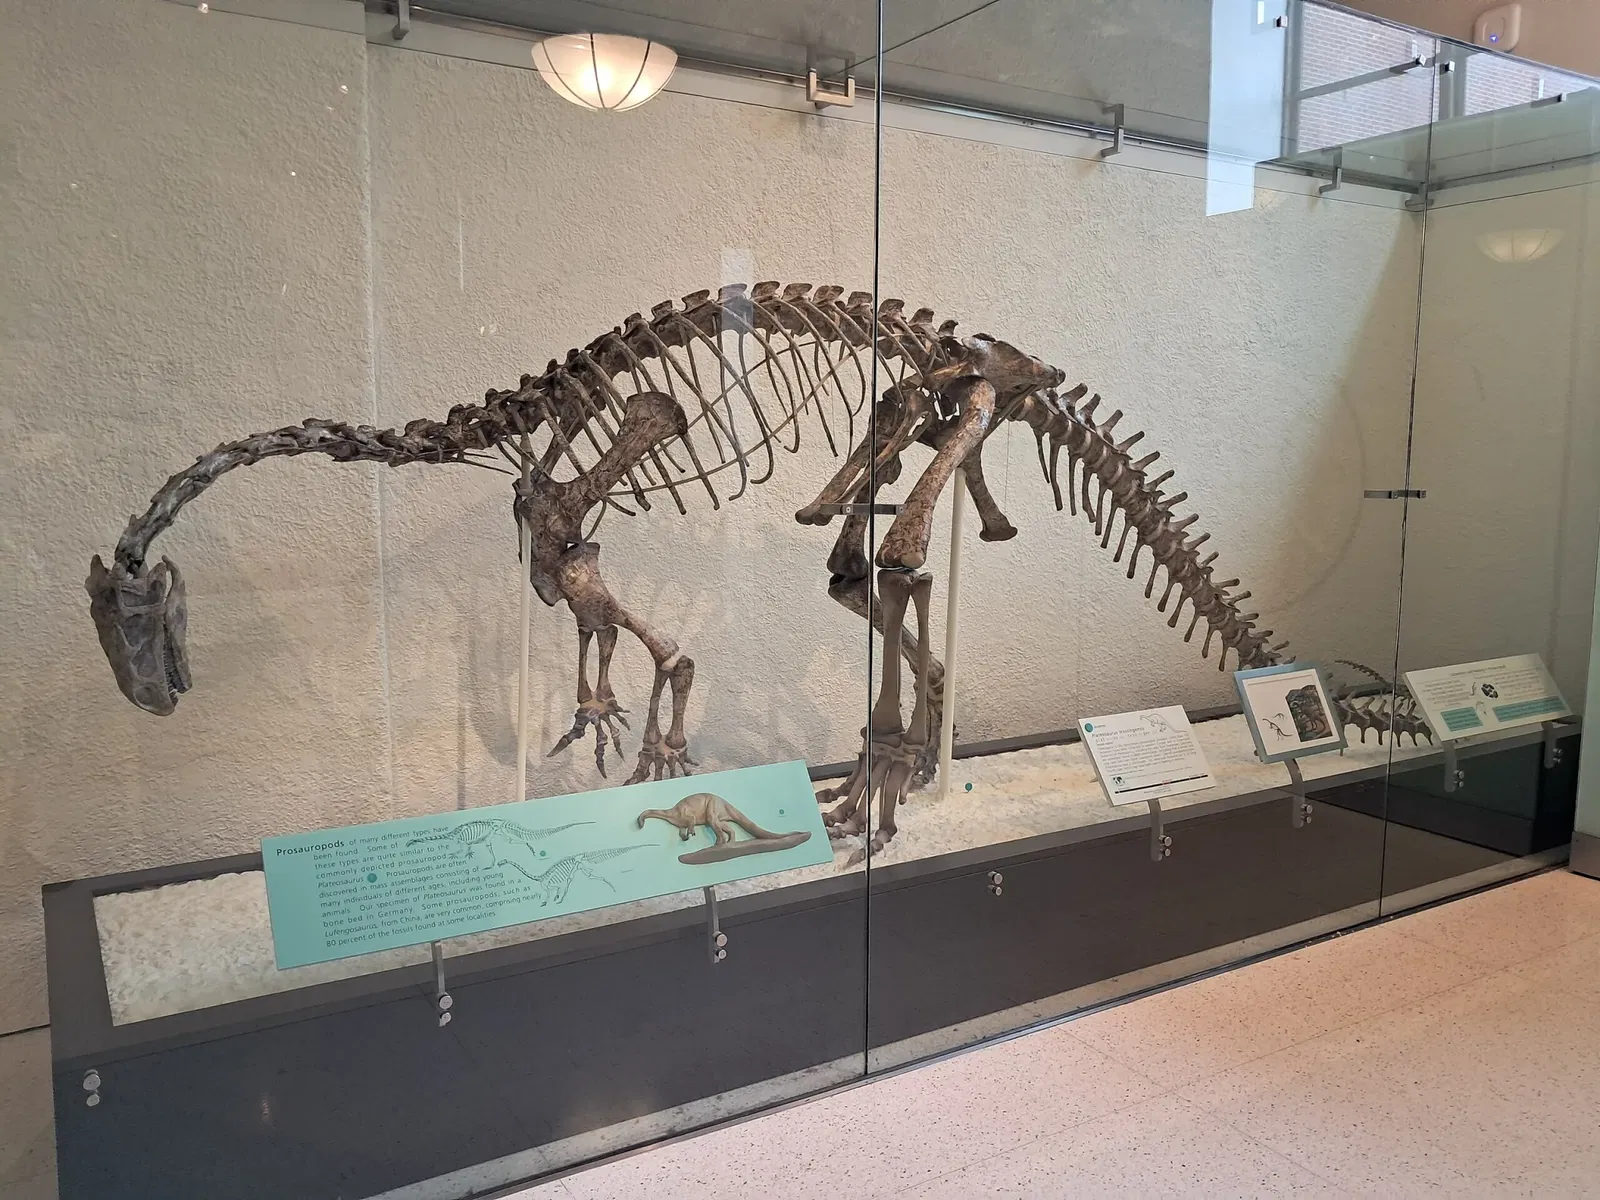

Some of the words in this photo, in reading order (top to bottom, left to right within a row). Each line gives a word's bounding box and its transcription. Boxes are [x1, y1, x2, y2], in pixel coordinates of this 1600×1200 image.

[276, 840, 345, 856] Prosauropods
[381, 832, 410, 840] different
[413, 829, 431, 837] types
[315, 862, 336, 870] these
[339, 858, 359, 867] types
[377, 852, 396, 861] quite
[400, 848, 424, 857] similar
[316, 868, 357, 879] commonly
[361, 862, 395, 872] depicted
[398, 854, 446, 867] prosauropod
[386, 866, 434, 877] Prosauropods
[319, 887, 357, 898] discovered
[391, 875, 433, 887] assemblages
[436, 868, 469, 879] consisting
[343, 893, 382, 904] individuals
[395, 885, 426, 896] different
[449, 876, 480, 886] including
[483, 872, 504, 881] young
[376, 898, 409, 909] specimen
[423, 888, 466, 900] Plateosaurus
[485, 881, 506, 889] found
[323, 919, 344, 928] bone
[348, 915, 363, 923] bed
[421, 902, 443, 910] Some
[503, 887, 520, 896] such
[381, 919, 399, 927] from
[485, 897, 521, 908] comprising
[522, 893, 541, 901] nearly
[338, 935, 366, 946] percent
[378, 930, 390, 938] the
[391, 926, 413, 935] fossils
[415, 922, 436, 930] found
